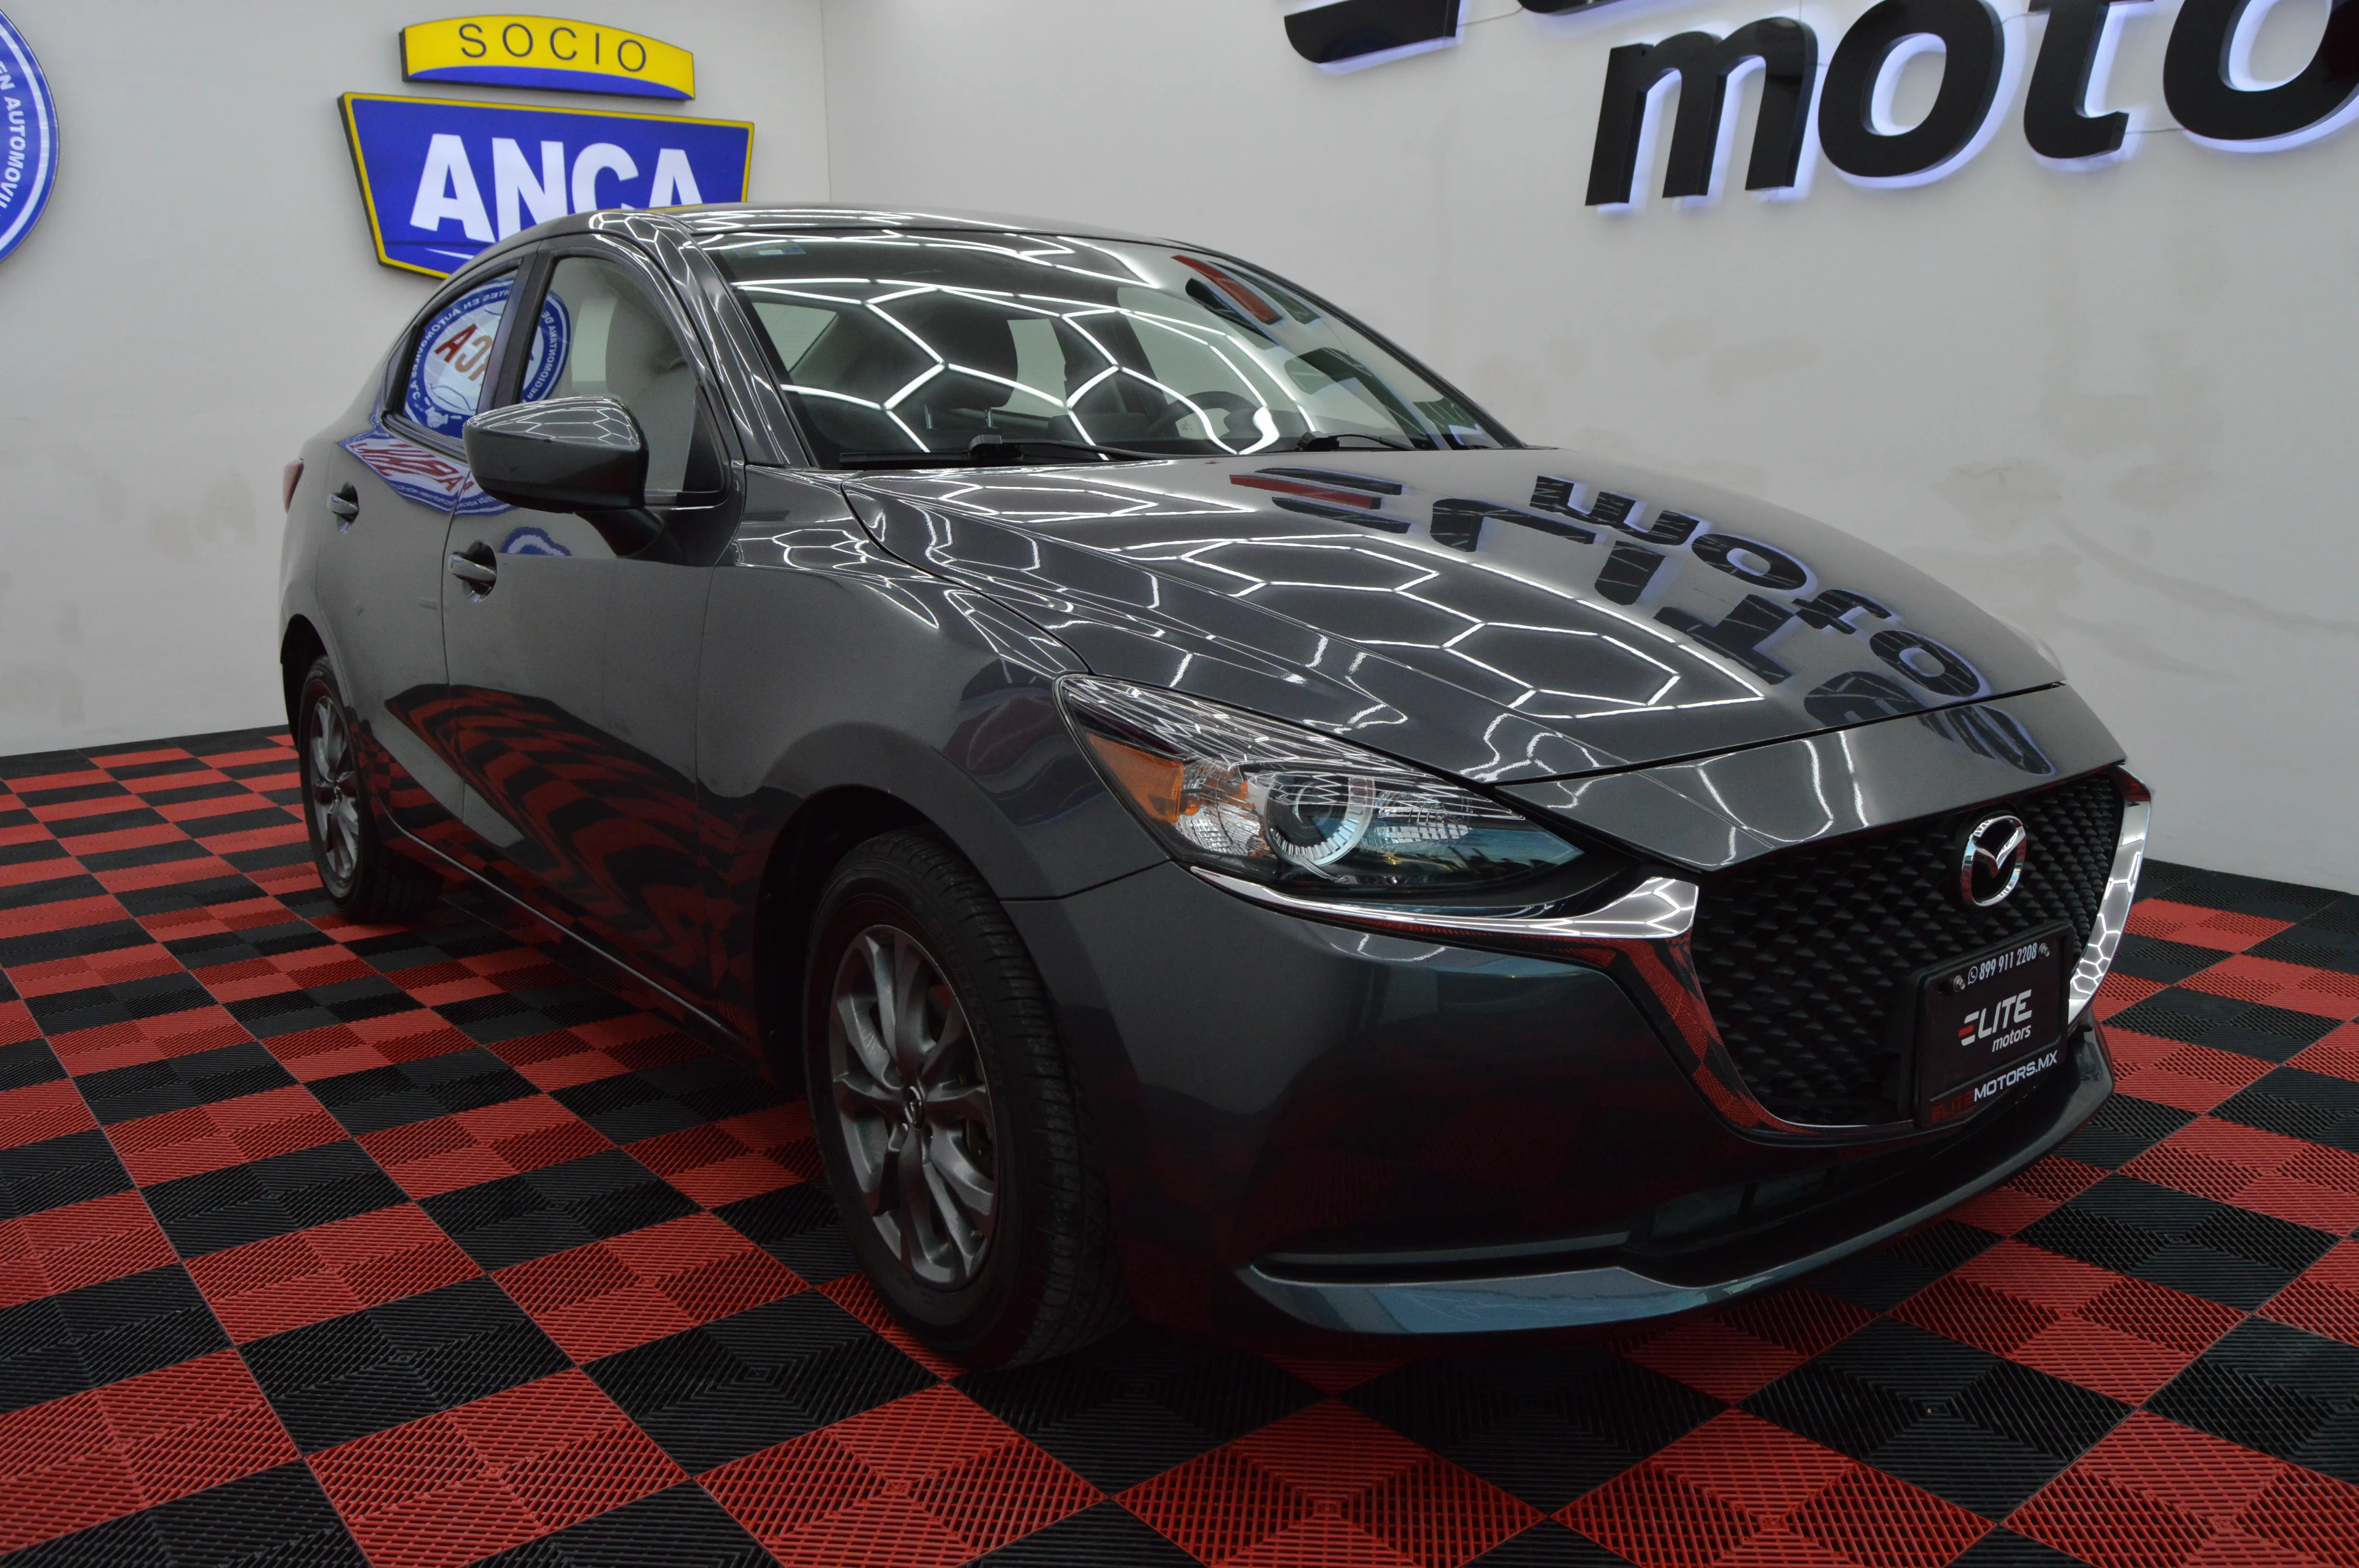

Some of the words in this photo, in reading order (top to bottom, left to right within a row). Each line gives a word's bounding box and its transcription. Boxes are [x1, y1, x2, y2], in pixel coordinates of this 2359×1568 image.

[460, 23, 647, 72] SOCIO
[409, 133, 703, 243] ANCA
[1979, 959, 1997, 981] 899
[1998, 951, 2014, 973] 911
[2016, 942, 2037, 966] 2208
[1958, 989, 2033, 1046] ELITE
[1991, 1024, 2032, 1053] motors
